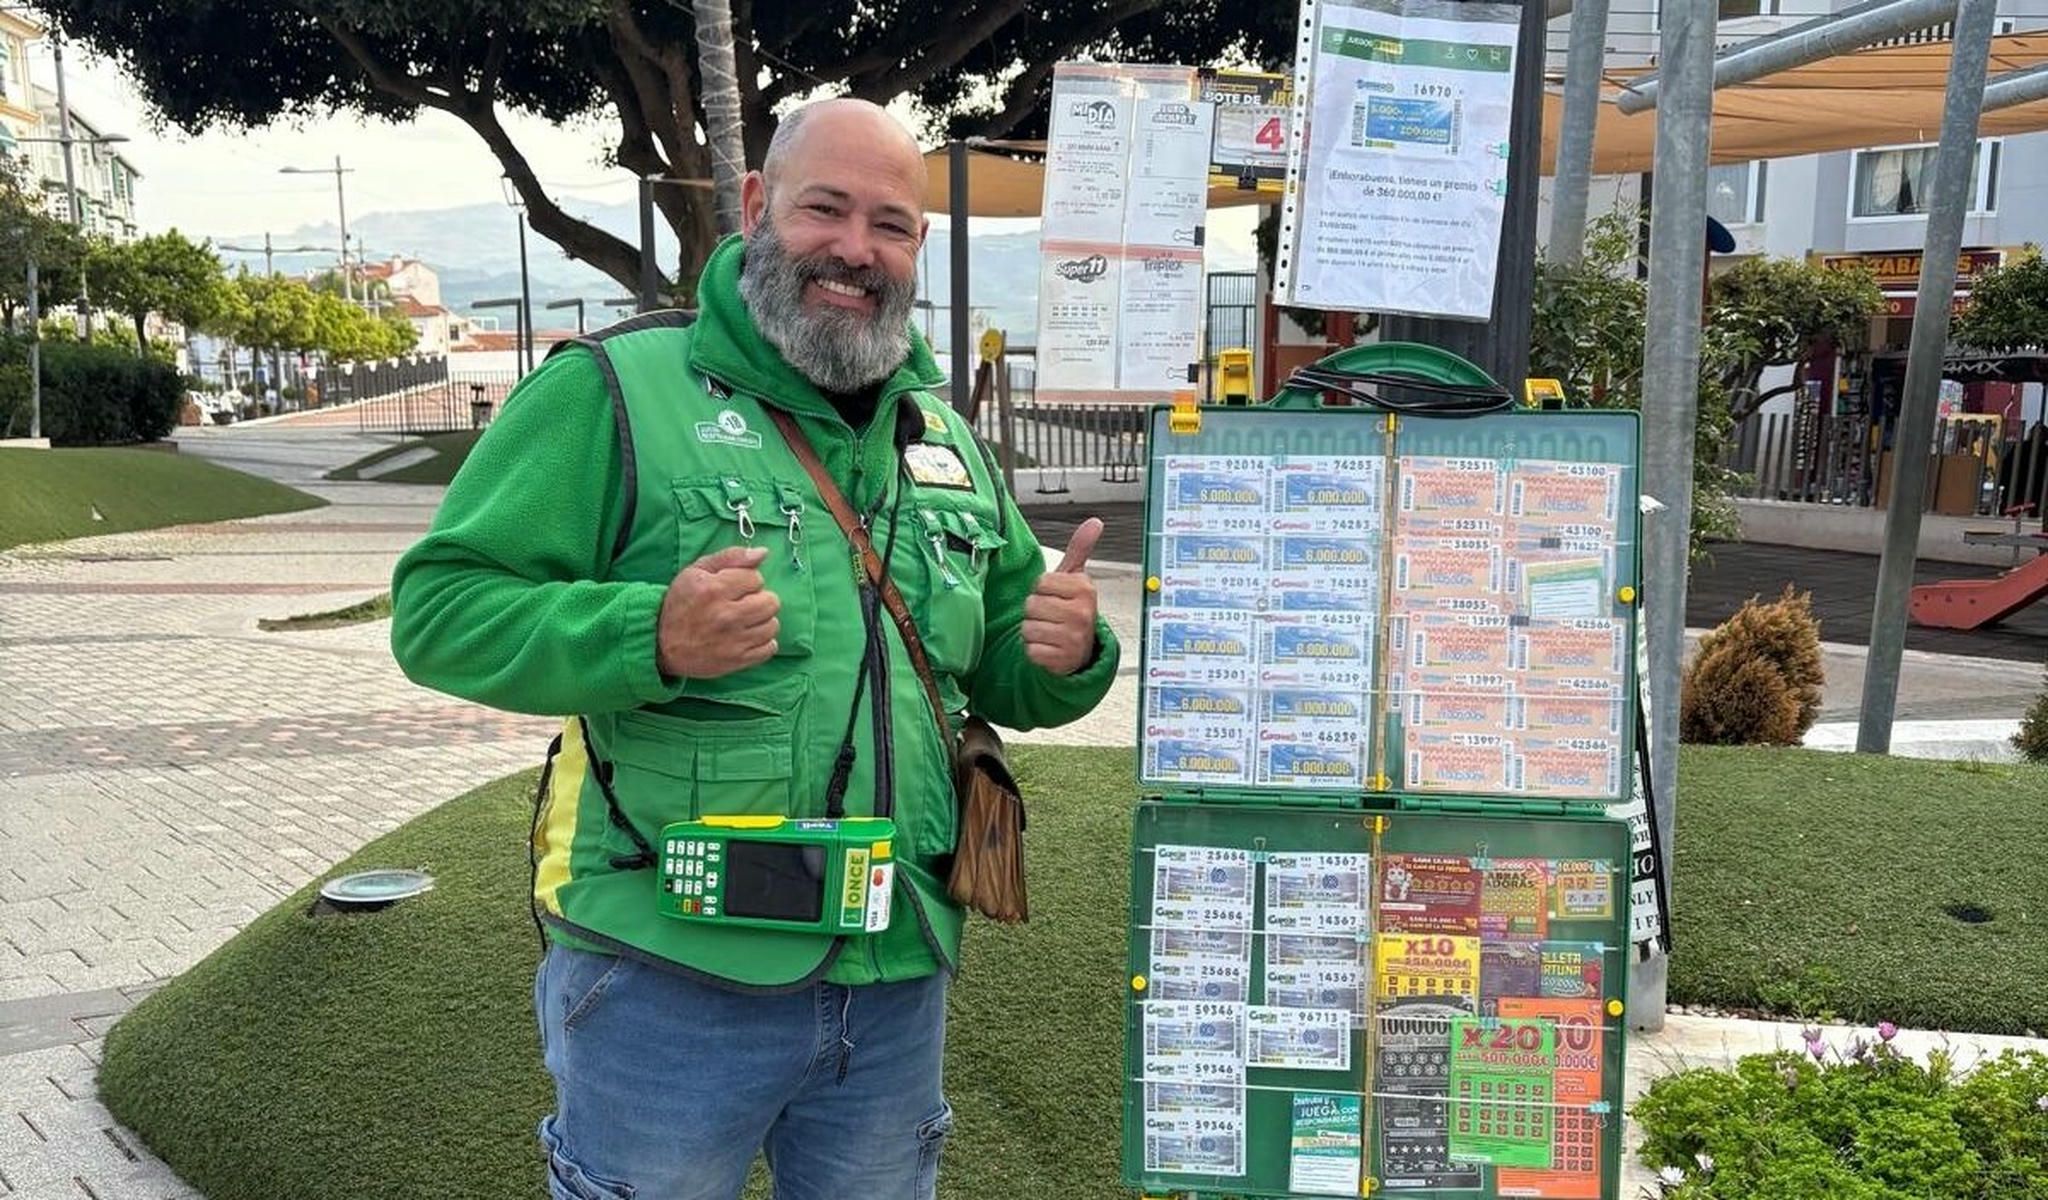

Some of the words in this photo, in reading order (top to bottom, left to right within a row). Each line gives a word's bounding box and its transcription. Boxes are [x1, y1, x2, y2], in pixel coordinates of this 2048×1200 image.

[1413, 84, 1452, 97] 16970
[1243, 95, 1261, 104] DE
[1207, 850, 1246, 862] 25684
[1319, 856, 1357, 866] 14367
[849, 855, 864, 904] ONCE
[1204, 909, 1243, 920] 25684
[1319, 914, 1357, 926] 14367
[1201, 966, 1240, 977] 25684
[1318, 972, 1356, 983] 14367
[1195, 1004, 1233, 1015] 59346
[1298, 1013, 1337, 1024] 96713
[1195, 1062, 1233, 1073] 59346
[1195, 1120, 1233, 1131] 59346
